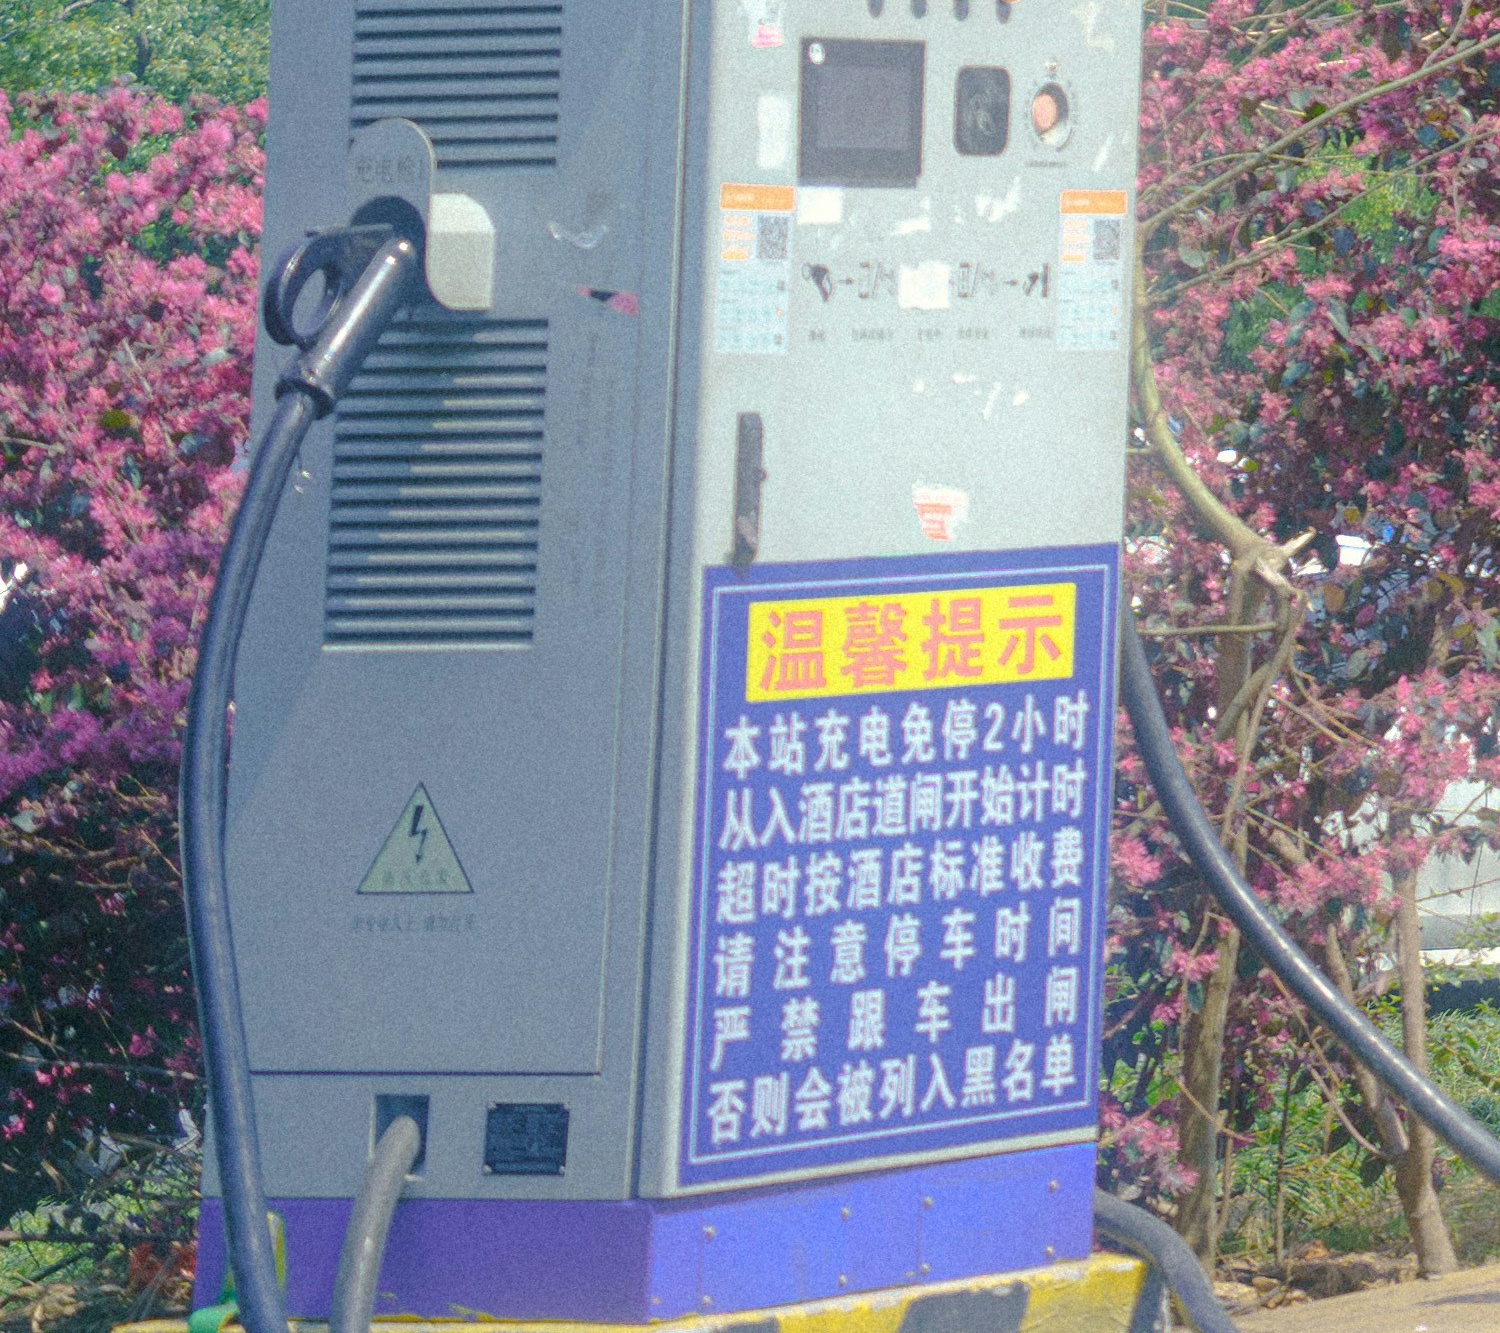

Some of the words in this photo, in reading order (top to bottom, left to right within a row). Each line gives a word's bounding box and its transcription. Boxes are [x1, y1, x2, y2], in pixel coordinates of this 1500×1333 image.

[759, 595, 1063, 692] 温馨提示
[723, 688, 1091, 781] 本站充电免停2小时
[718, 757, 1087, 853] 从入酒店道闸开始计时
[715, 825, 1084, 925] 超时按酒店标准收费
[712, 896, 1082, 999] 请注意停车时间
[709, 965, 1080, 1073] 严禁跟车出闸
[706, 1033, 1077, 1146] 否则会被列入黑名单
